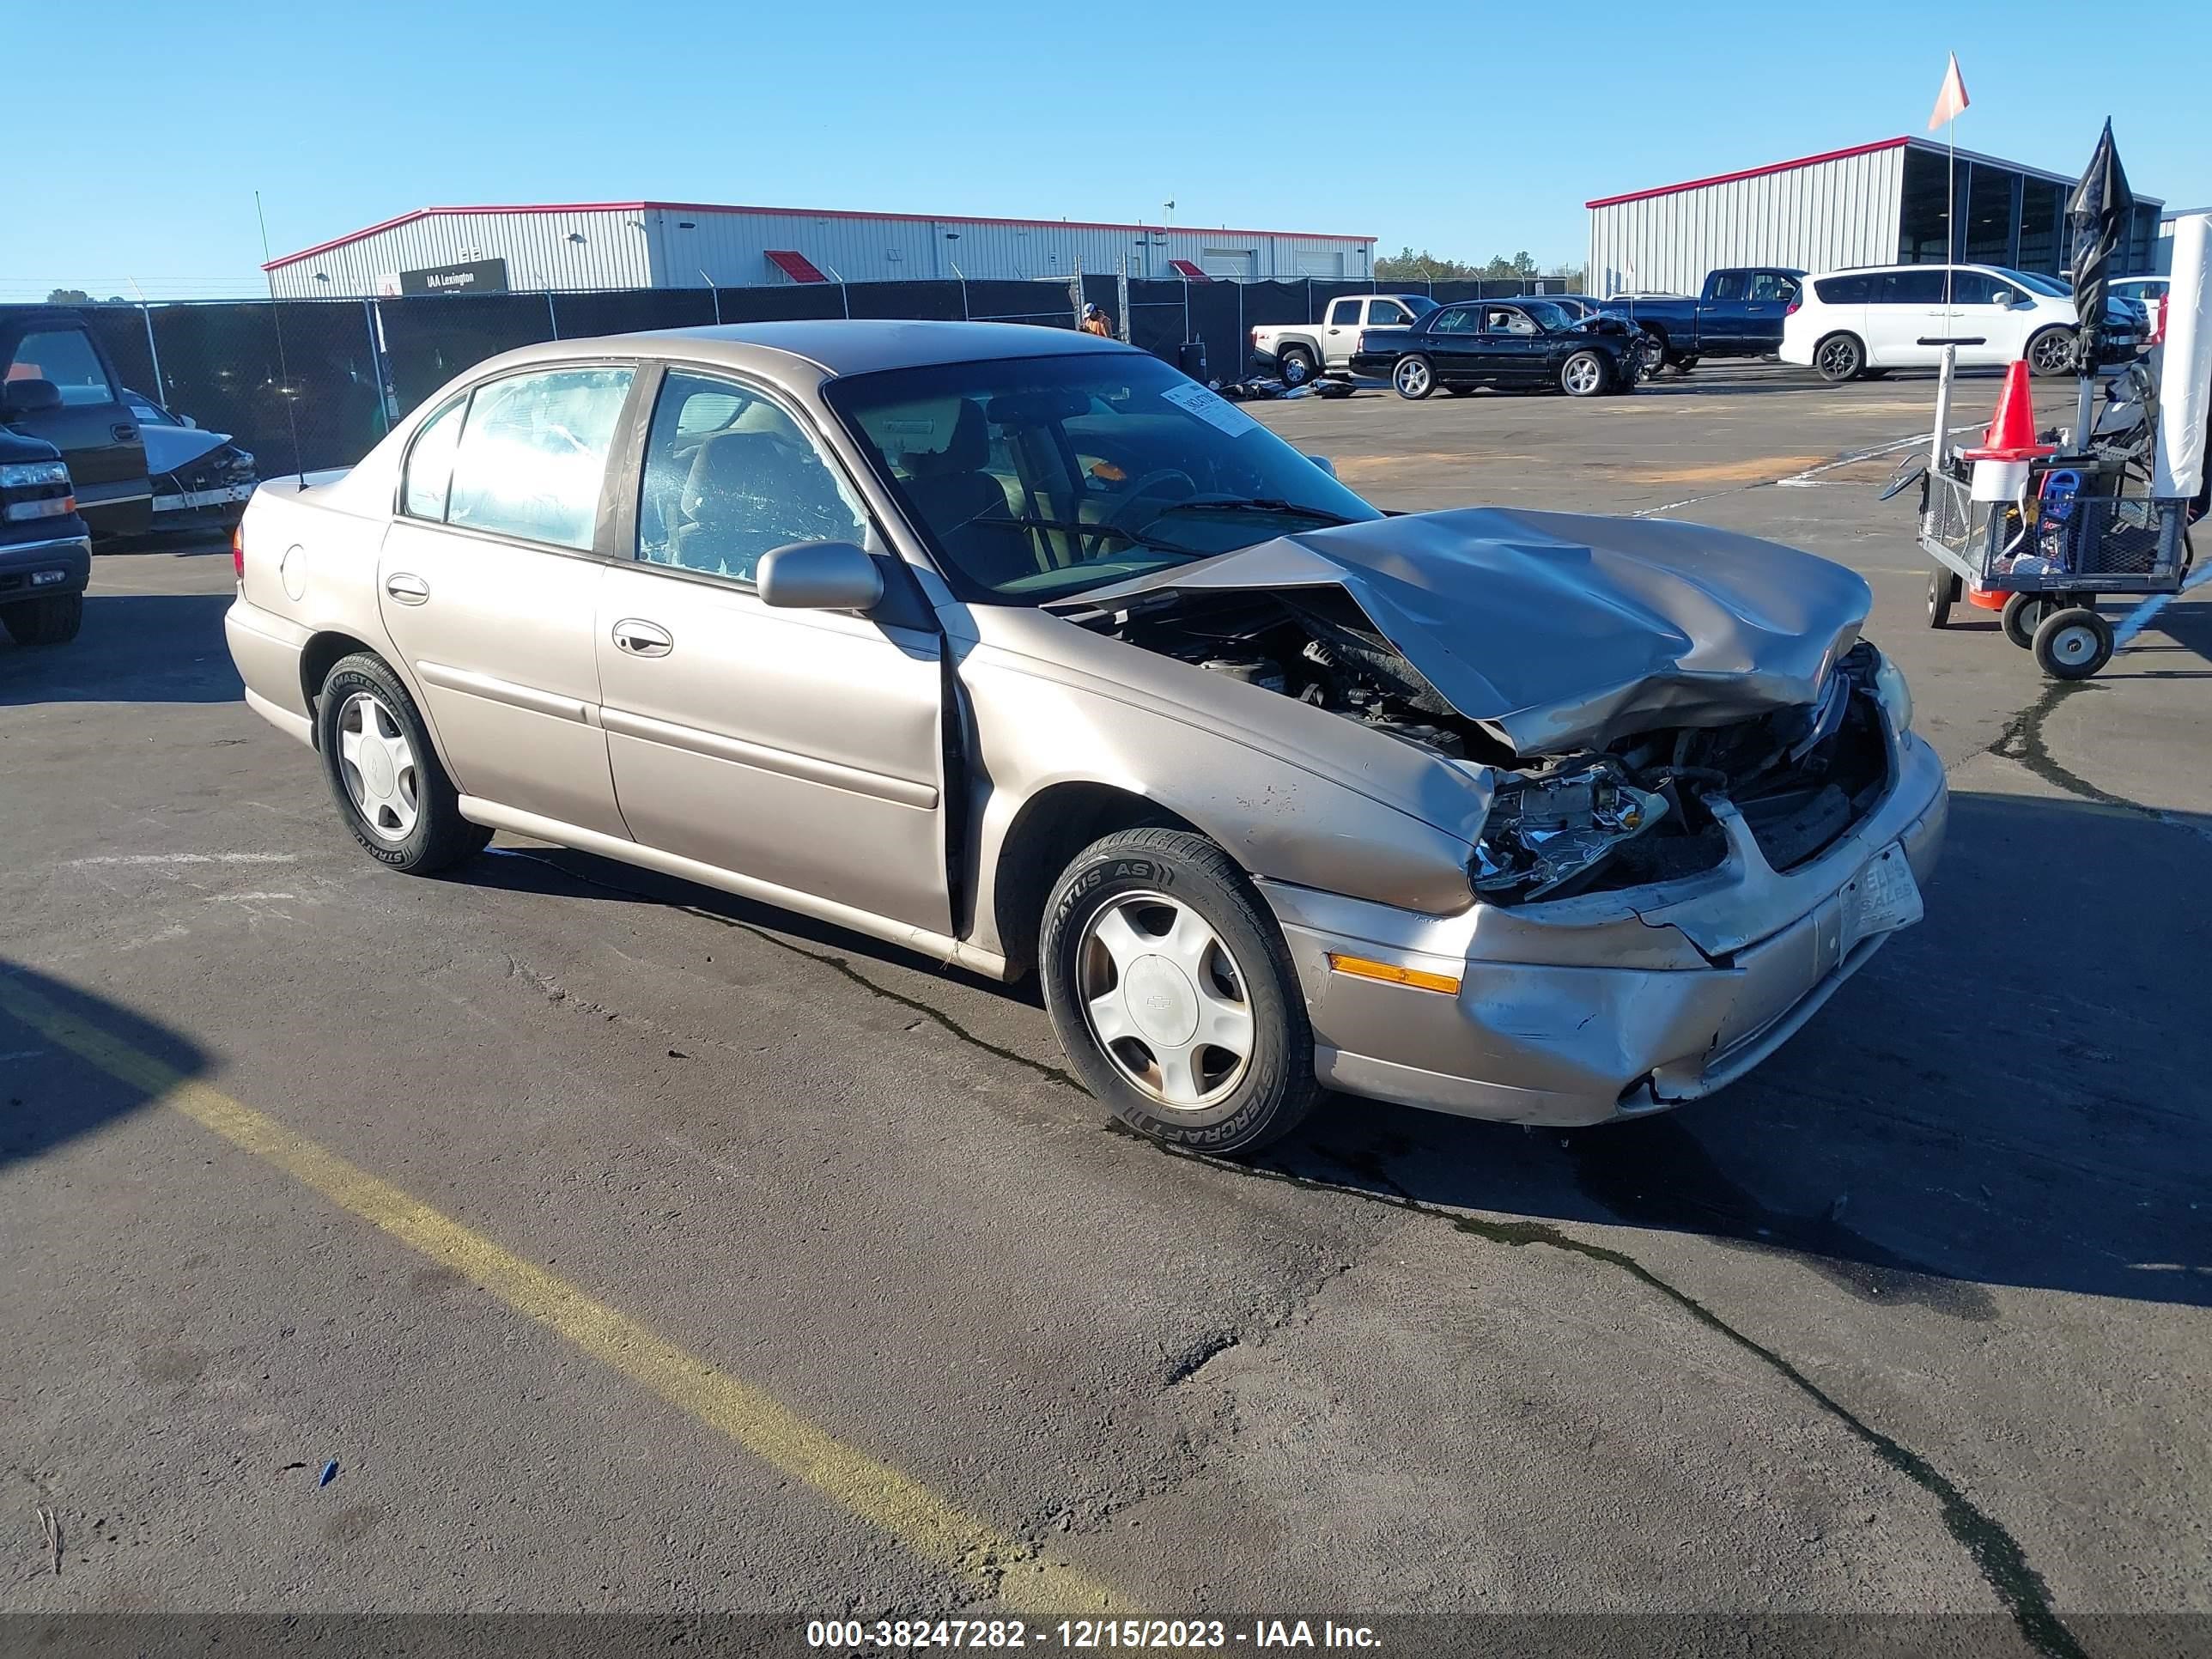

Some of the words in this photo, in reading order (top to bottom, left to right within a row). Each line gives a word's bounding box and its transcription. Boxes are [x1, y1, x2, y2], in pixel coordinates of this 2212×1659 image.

[427, 275, 441, 288] IAA
[441, 271, 474, 287] Lexington
[1861, 882, 1913, 911] SALES
[1048, 868, 1102, 974] STRATUS
[1115, 863, 1149, 877] AS
